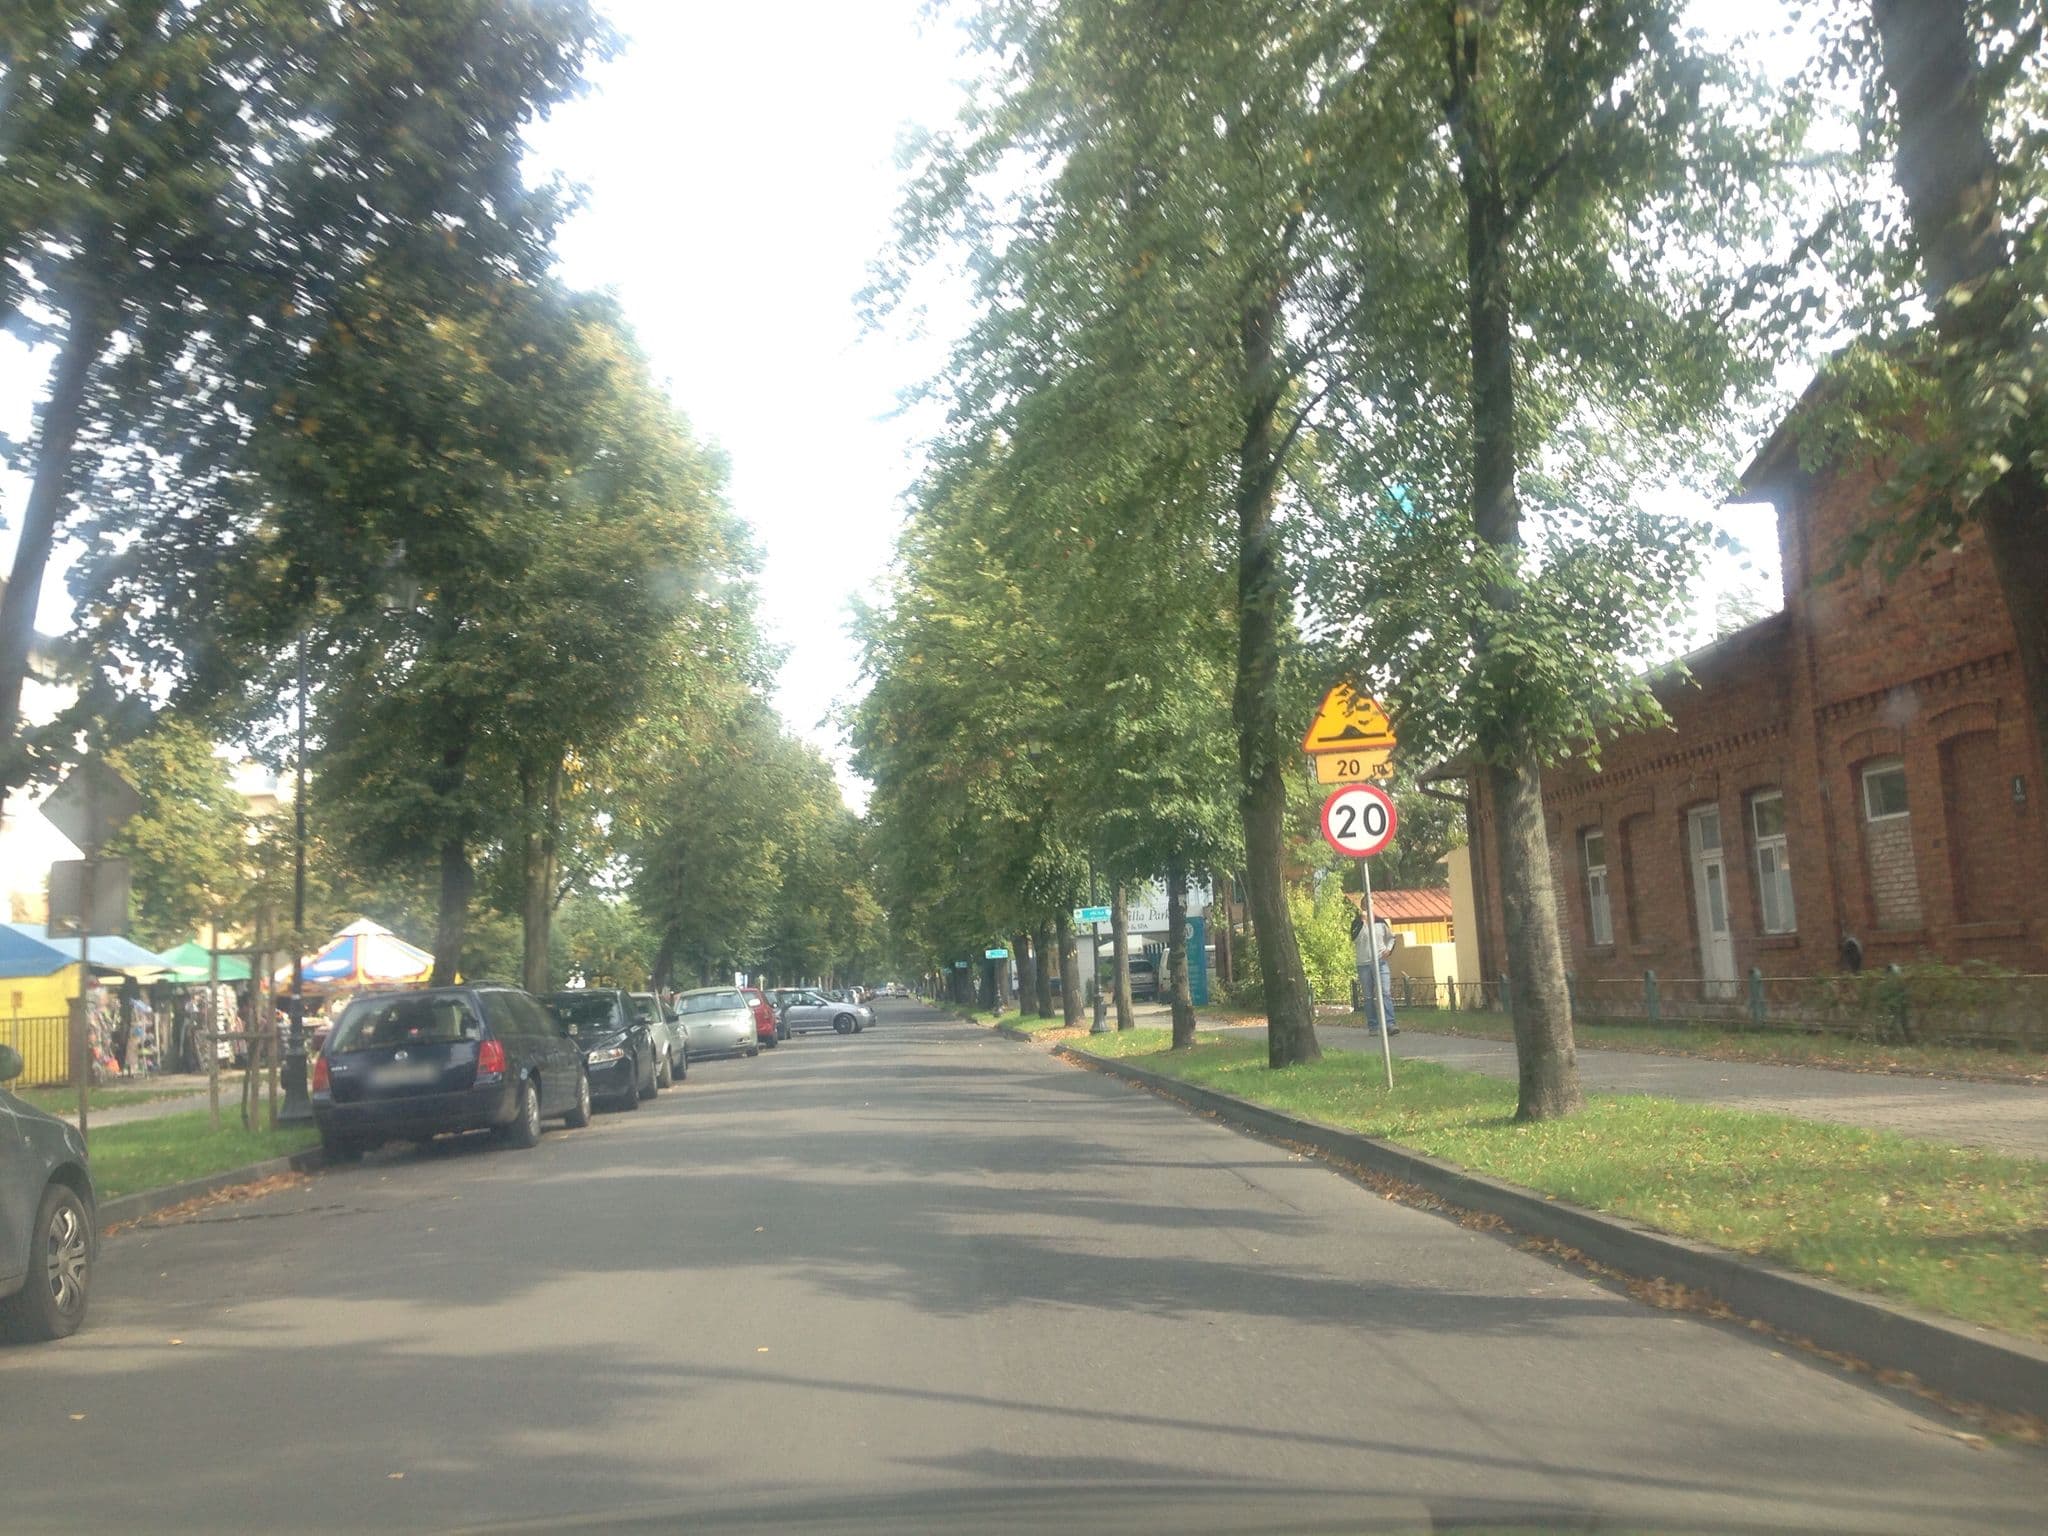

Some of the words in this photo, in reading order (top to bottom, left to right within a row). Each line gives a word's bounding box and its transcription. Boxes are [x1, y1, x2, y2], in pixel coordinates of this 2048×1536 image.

[1336, 759, 1361, 776] 20
[1335, 803, 1387, 839] 20
[1127, 910, 1145, 921] illa
